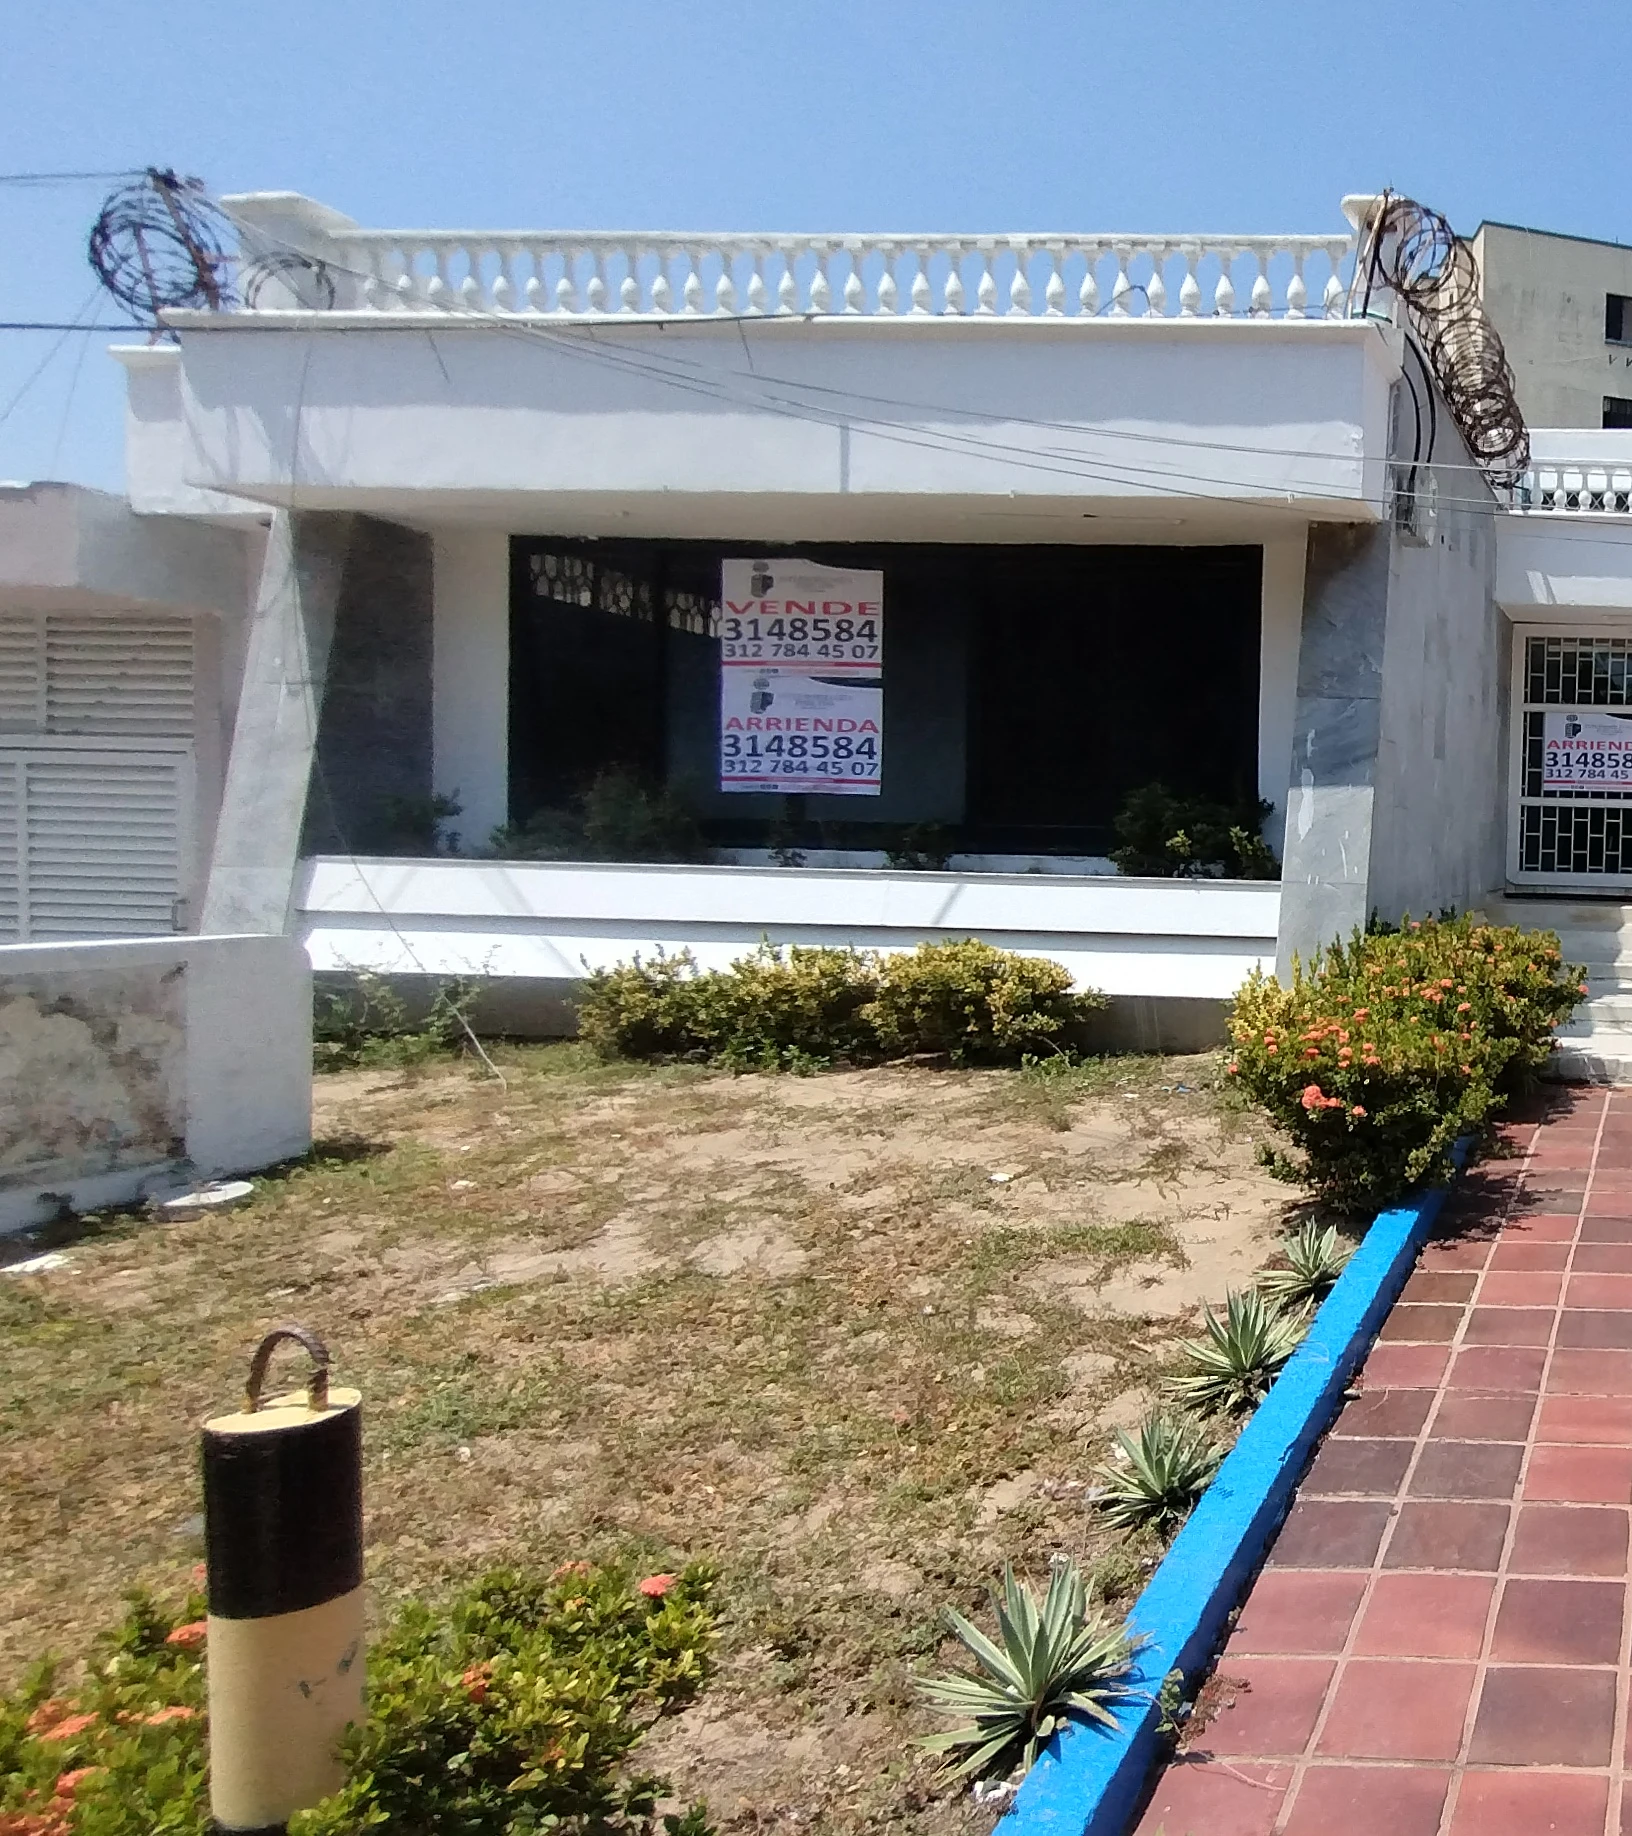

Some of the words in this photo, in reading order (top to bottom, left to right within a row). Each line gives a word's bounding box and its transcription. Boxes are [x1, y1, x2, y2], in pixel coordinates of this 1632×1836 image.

[726, 600, 879, 616] VENDE
[725, 618, 878, 642] 3148584
[725, 643, 762, 658] 312
[771, 643, 810, 658] 784
[817, 644, 845, 659] 45
[851, 644, 879, 659] 07
[725, 717, 879, 733] ARRIENDA
[724, 734, 877, 760] 3148584
[724, 760, 762, 773] 312
[770, 760, 809, 774] 784
[816, 761, 844, 775] 45
[851, 762, 879, 776] 07
[1545, 769, 1573, 779] 312
[1579, 769, 1606, 779] 784
[1610, 770, 1629, 780] 45
